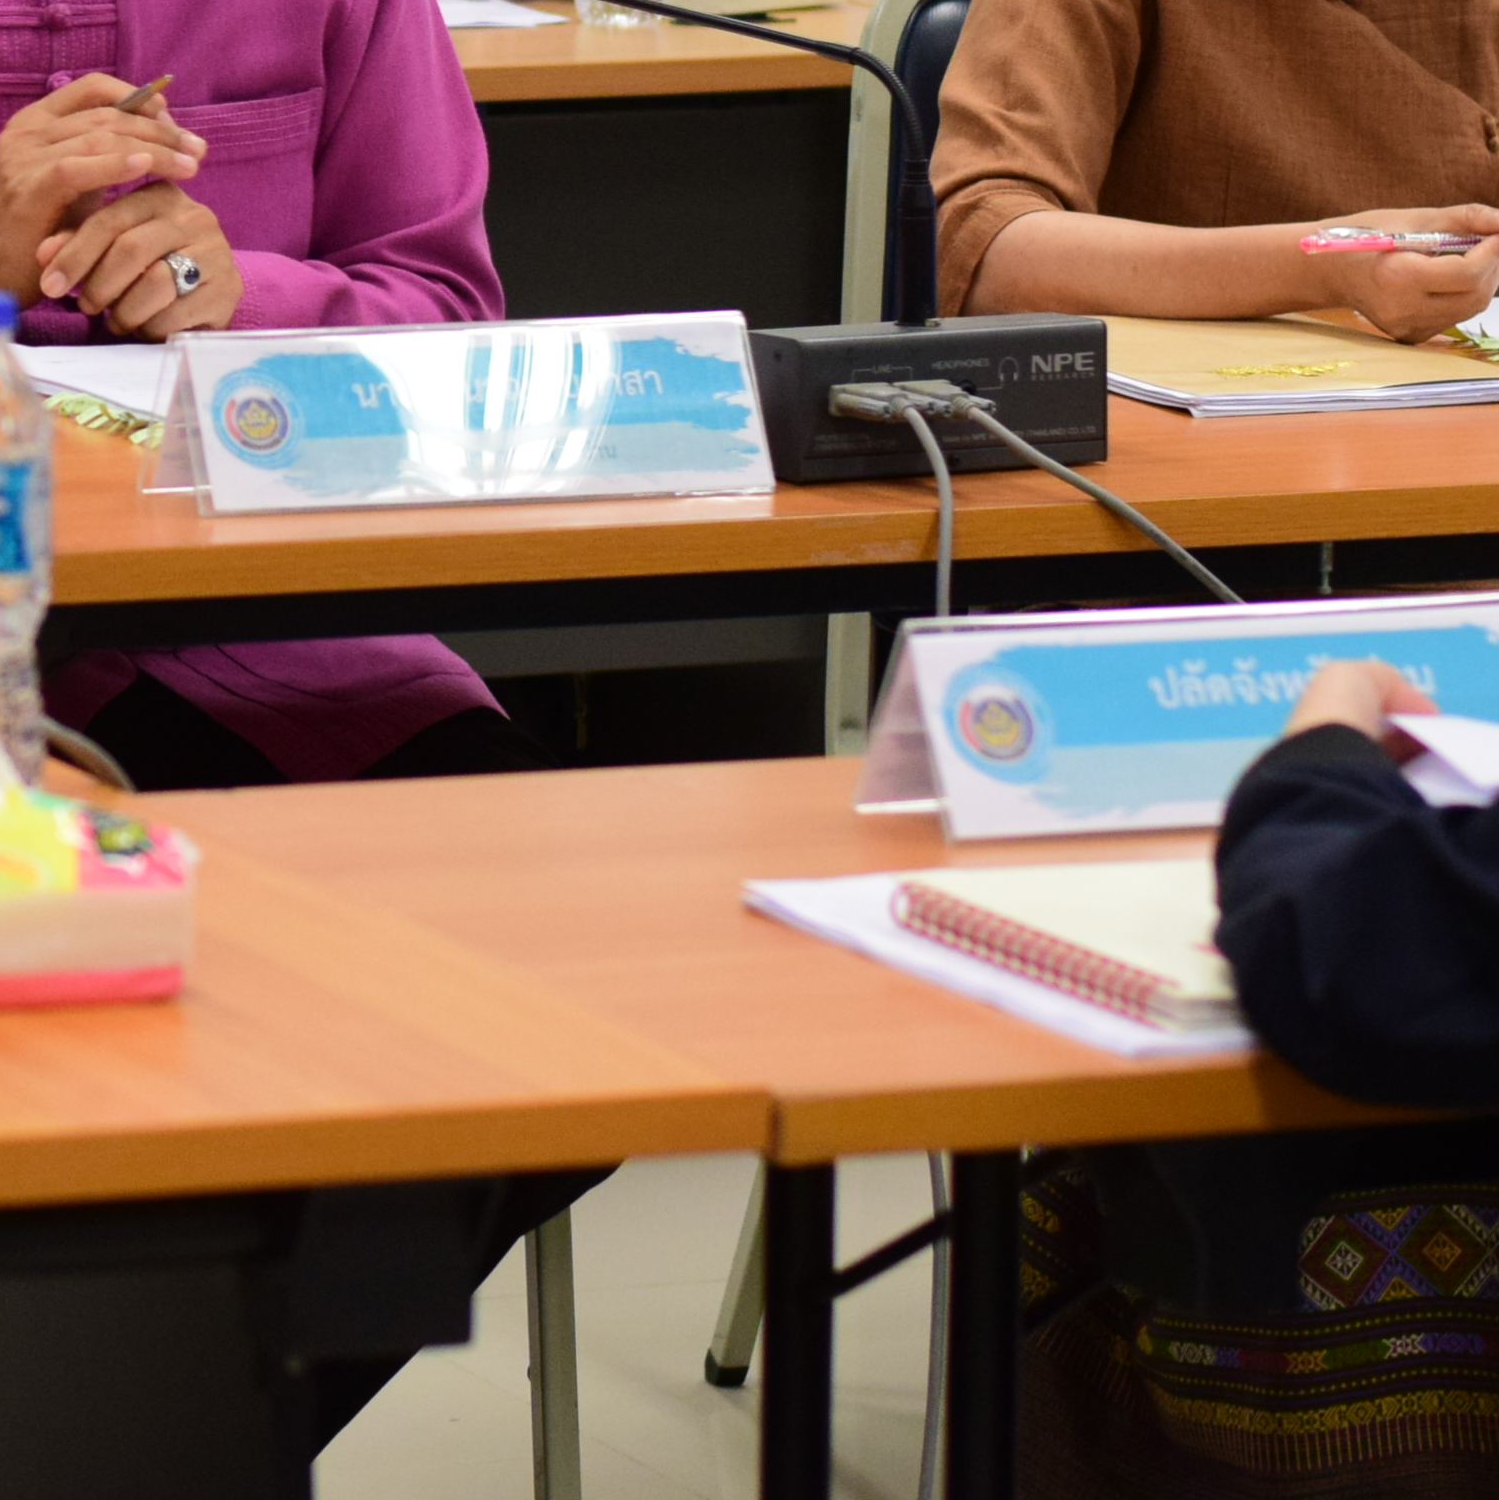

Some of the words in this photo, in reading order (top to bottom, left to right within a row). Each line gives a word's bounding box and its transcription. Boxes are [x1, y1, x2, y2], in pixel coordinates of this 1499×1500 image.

[872, 362, 893, 376] LINE
[931, 357, 991, 371] HEADPHONES
[1031, 351, 1096, 374] NPE
